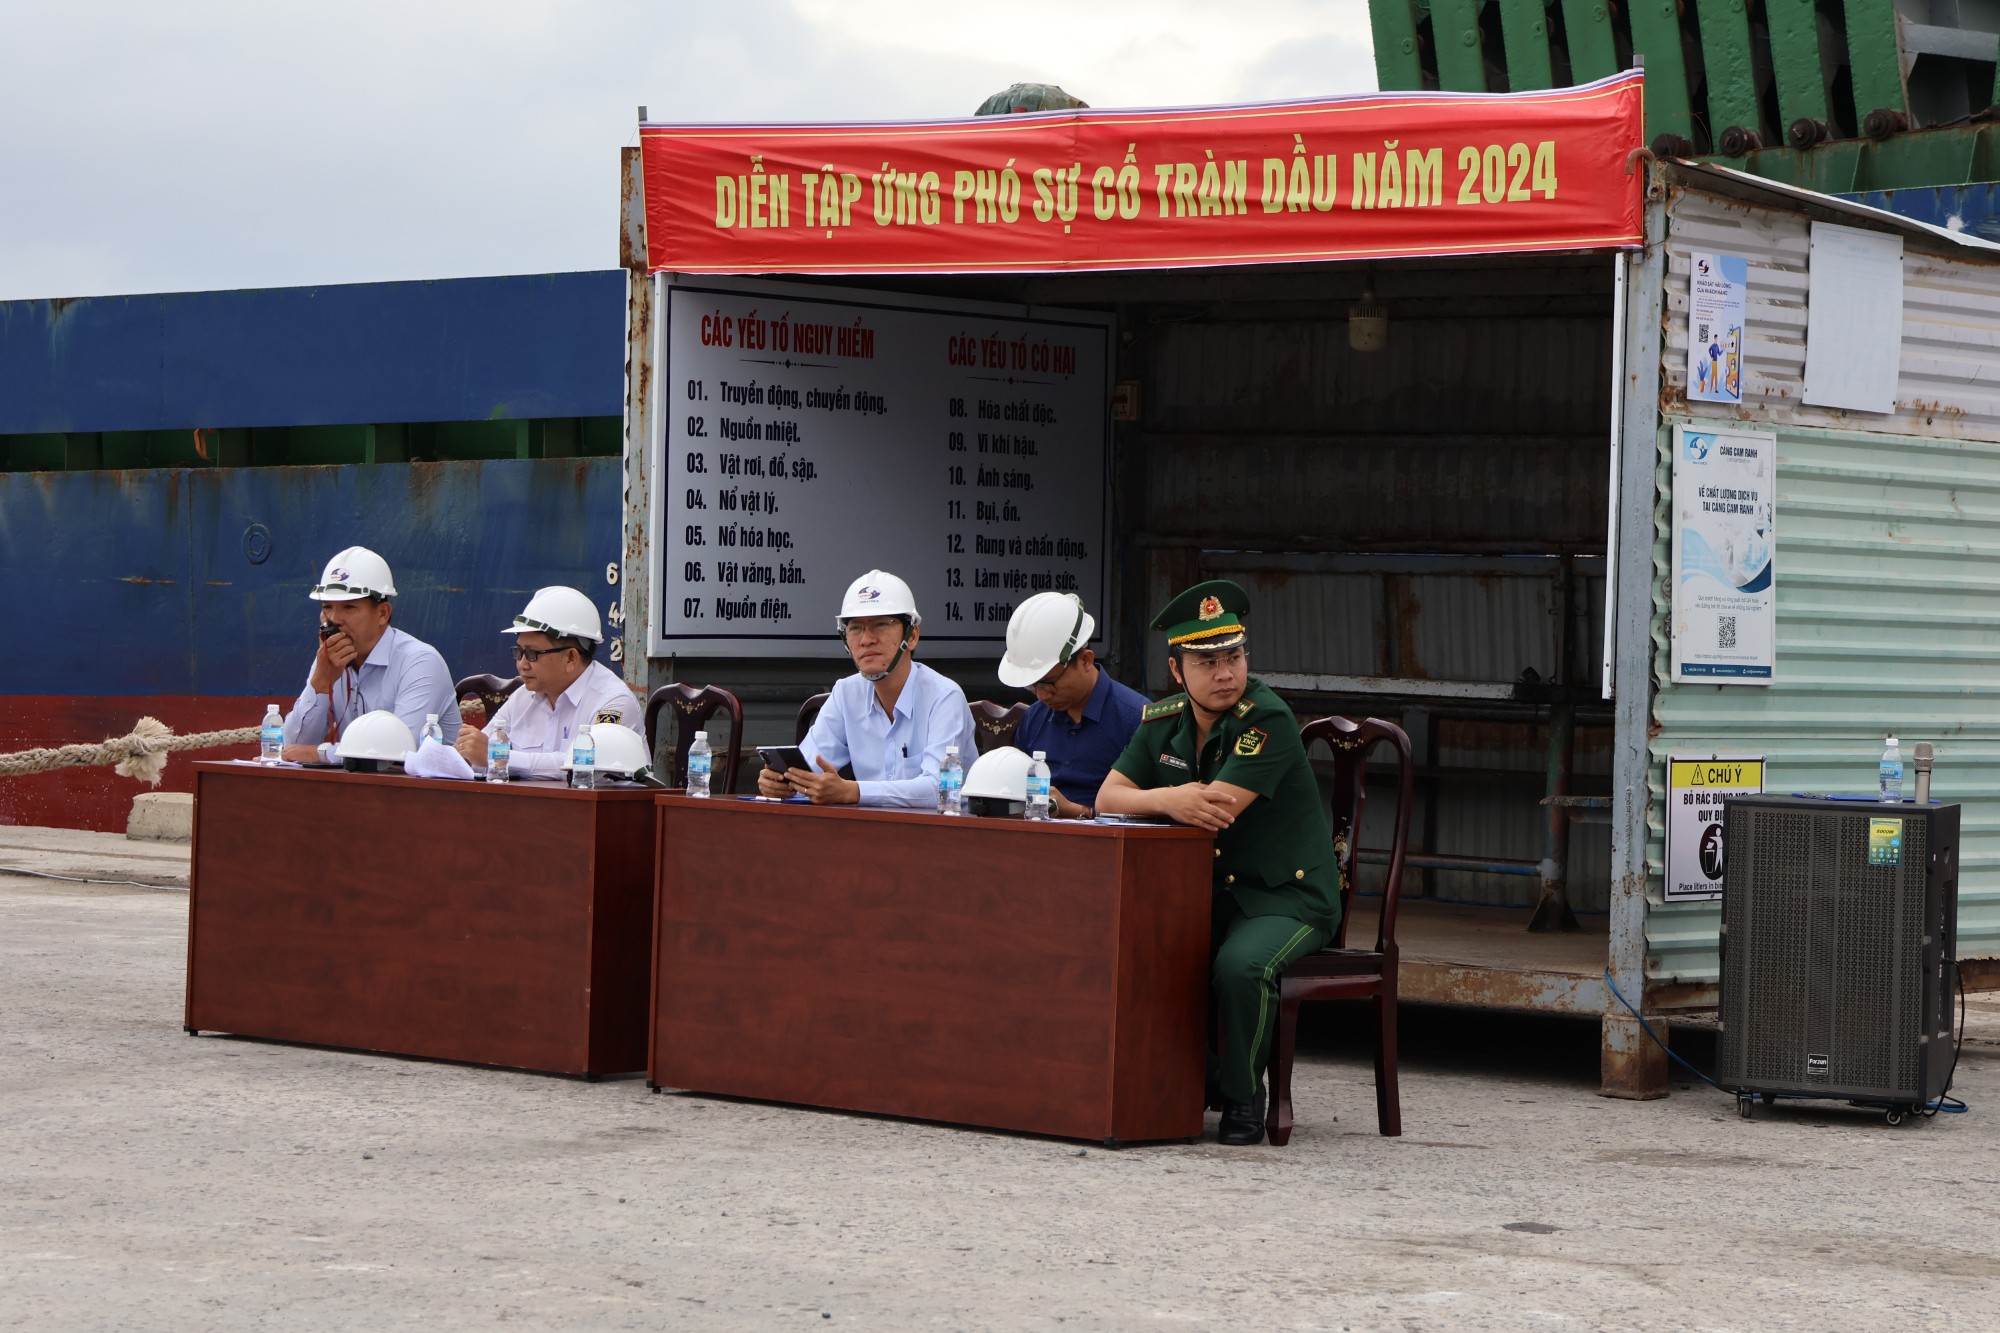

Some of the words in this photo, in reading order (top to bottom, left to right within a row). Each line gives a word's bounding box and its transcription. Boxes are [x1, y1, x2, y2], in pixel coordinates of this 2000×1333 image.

[715, 155, 789, 229] DIỄN
[801, 163, 863, 239] TẬP
[873, 161, 940, 226] ỨNG
[953, 158, 1020, 224] PHÓ
[1032, 161, 1081, 233] SỰ
[1093, 143, 1141, 221] CỐ
[1155, 149, 1248, 218] TRÀN
[1262, 133, 1338, 214] DẦU
[1352, 139, 1443, 210] NĂM
[1457, 141, 1558, 205] 2024
[701, 310, 732, 347] CÁC
[738, 309, 766, 350] YẾU
[770, 312, 788, 352] TỐ
[793, 323, 834, 355] NGUY
[837, 315, 874, 359] HIỂM
[949, 331, 976, 367] CÁC
[981, 330, 1006, 369] YẾU
[1011, 332, 1027, 371] TỐ
[1032, 339, 1048, 373] CÓ
[1053, 346, 1076, 380] HẠI
[687, 379, 708, 401] 01.
[720, 380, 763, 406] Truyền
[767, 384, 802, 410] động,
[806, 384, 850, 410] chuyển
[854, 390, 888, 415] động.
[950, 398, 967, 418] 08.
[978, 400, 1000, 420] Hóa
[1004, 399, 1029, 422] chất
[1033, 403, 1057, 427] độc.
[687, 416, 708, 437] 02.
[720, 416, 761, 441] Nguồn
[765, 420, 801, 446] nhiệt.
[949, 432, 967, 452] 09.
[978, 433, 988, 452] Vi
[992, 435, 1010, 455] khí
[1014, 435, 1038, 459] hậu.
[1734, 448, 1744, 457] CAM
[1745, 449, 1758, 458] RANH
[687, 452, 708, 473] 03.
[720, 454, 740, 479] Vật
[744, 455, 765, 478] rơi,
[769, 452, 788, 480] đổ,
[792, 457, 817, 483] sập.
[949, 466, 966, 486] 10.
[977, 463, 999, 487] Ánh
[1003, 468, 1034, 492] sáng.
[686, 489, 707, 509] 04.
[719, 486, 737, 511] Nổ
[741, 491, 760, 517] vật
[764, 491, 779, 514] lý.
[948, 501, 965, 519] 11.
[977, 501, 1000, 525] Bụi,
[1727, 504, 1738, 514] CAM
[1740, 505, 1754, 515] RANH
[685, 525, 706, 546] 05.
[718, 522, 737, 547] Nổ
[740, 526, 763, 548] hóa
[767, 528, 794, 552] học.
[947, 534, 965, 553] 12.
[976, 535, 1005, 557] Rung
[1009, 536, 1021, 554] và
[1025, 533, 1053, 557] chấn
[1057, 537, 1088, 561] động.
[606, 562, 618, 585] 6
[685, 561, 705, 582] 06.
[718, 561, 738, 587] Vật
[742, 563, 776, 586] văng,
[780, 559, 805, 584] bắn.
[946, 568, 964, 587] 13.
[975, 568, 999, 588] Làm
[1003, 570, 1027, 592] việc
[1031, 571, 1052, 591] quá
[1055, 571, 1079, 590] sức.
[608, 602, 620, 628] 4
[684, 598, 704, 618] 07.
[716, 594, 757, 620] Nguồn
[761, 599, 791, 623] điện.
[945, 602, 963, 621] 14.
[974, 602, 984, 622] Vi
[610, 637, 622, 661] 2
[1708, 764, 1731, 783] CHÚ
[1735, 764, 1742, 783] Ý
[1684, 790, 1693, 804] BỎ
[1696, 791, 1710, 804] RÁC
[1698, 810, 1712, 822] QUY
